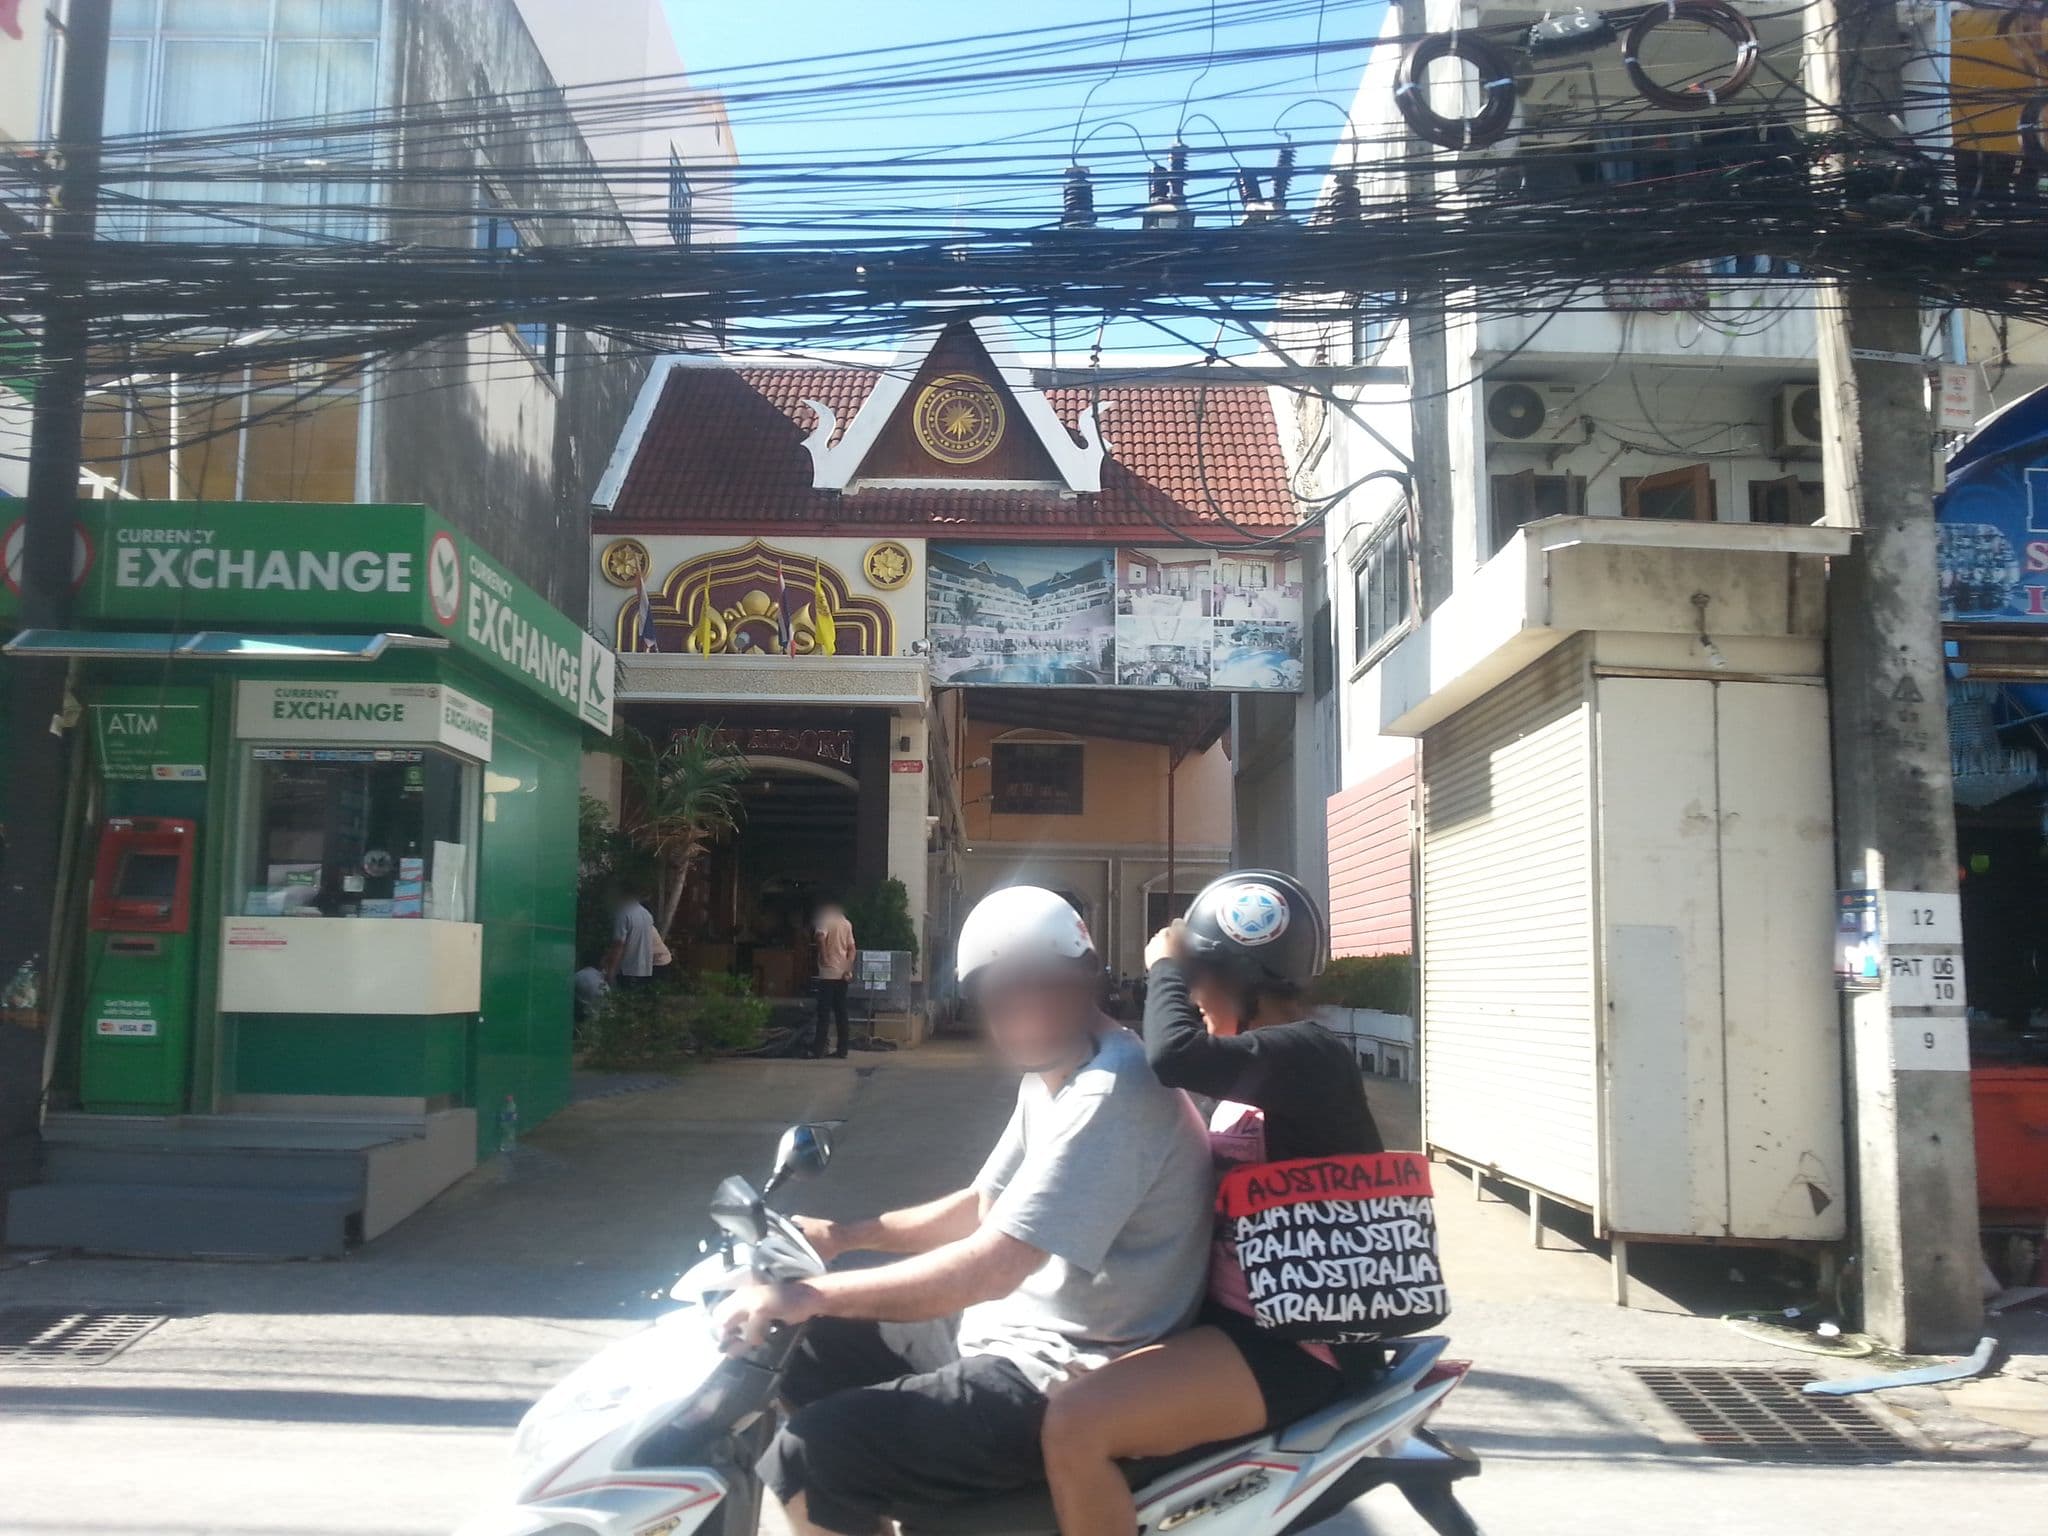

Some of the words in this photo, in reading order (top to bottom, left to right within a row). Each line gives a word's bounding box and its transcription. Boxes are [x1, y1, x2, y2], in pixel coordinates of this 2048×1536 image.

[116, 528, 215, 545] CURRENCY
[116, 547, 412, 593] EXCHANGE
[469, 555, 513, 601] CURRENCY
[468, 582, 580, 704] EXCHANGE
[273, 687, 340, 700] CURRENCY
[272, 701, 405, 722] EXCHANGE
[107, 713, 158, 735] ATM
[445, 705, 489, 742] EXCHANGE
[1912, 908, 1935, 926] 12
[1891, 957, 1923, 977] PAT
[1933, 957, 1955, 975] 06
[1934, 982, 1955, 1000] 10
[1923, 1031, 1935, 1049] 9
[1247, 1158, 1422, 1206] AUSTRALIA
[1280, 1252, 1438, 1291] AUSTRALIA
